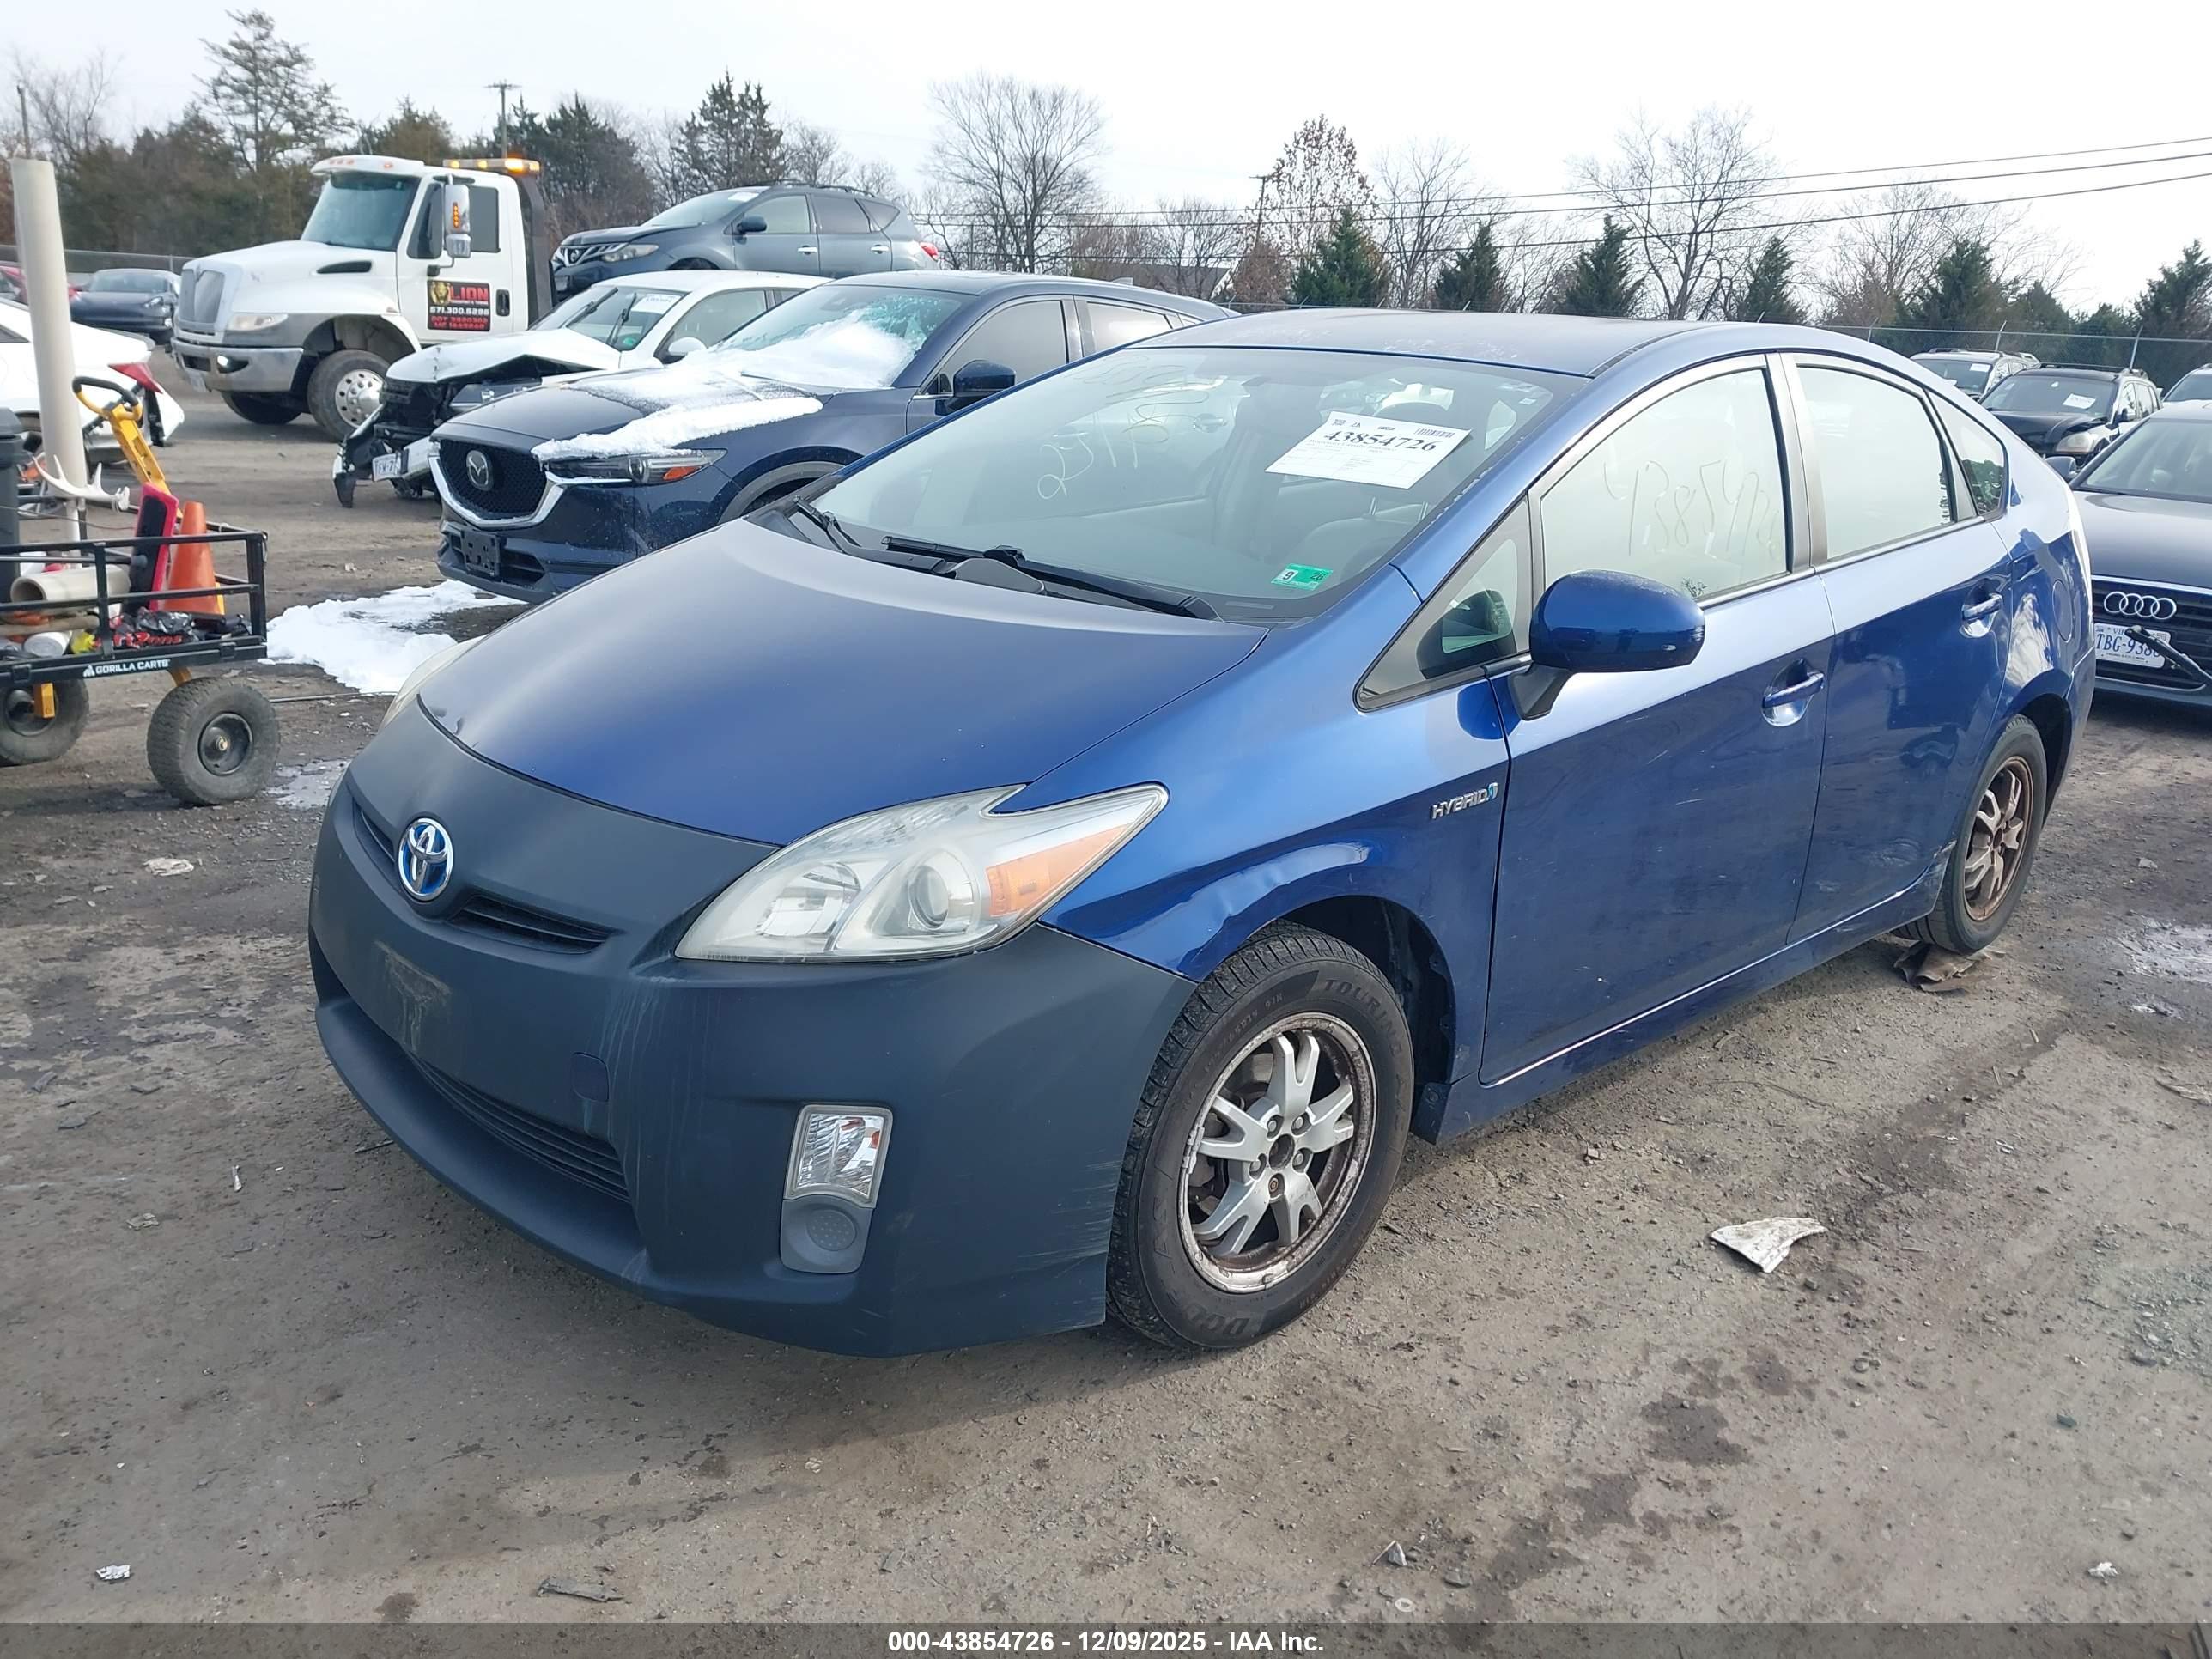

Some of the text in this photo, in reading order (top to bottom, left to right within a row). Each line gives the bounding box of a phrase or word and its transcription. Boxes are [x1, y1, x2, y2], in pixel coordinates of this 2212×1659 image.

[449, 285, 489, 301] LION
[1323, 429, 1443, 453] 43854726
[1282, 571, 1295, 580] 9
[95, 659, 169, 674] GORILLA CARTS
[1431, 788, 1487, 819] HYBRID
[1324, 978, 1403, 1056] TOURING
